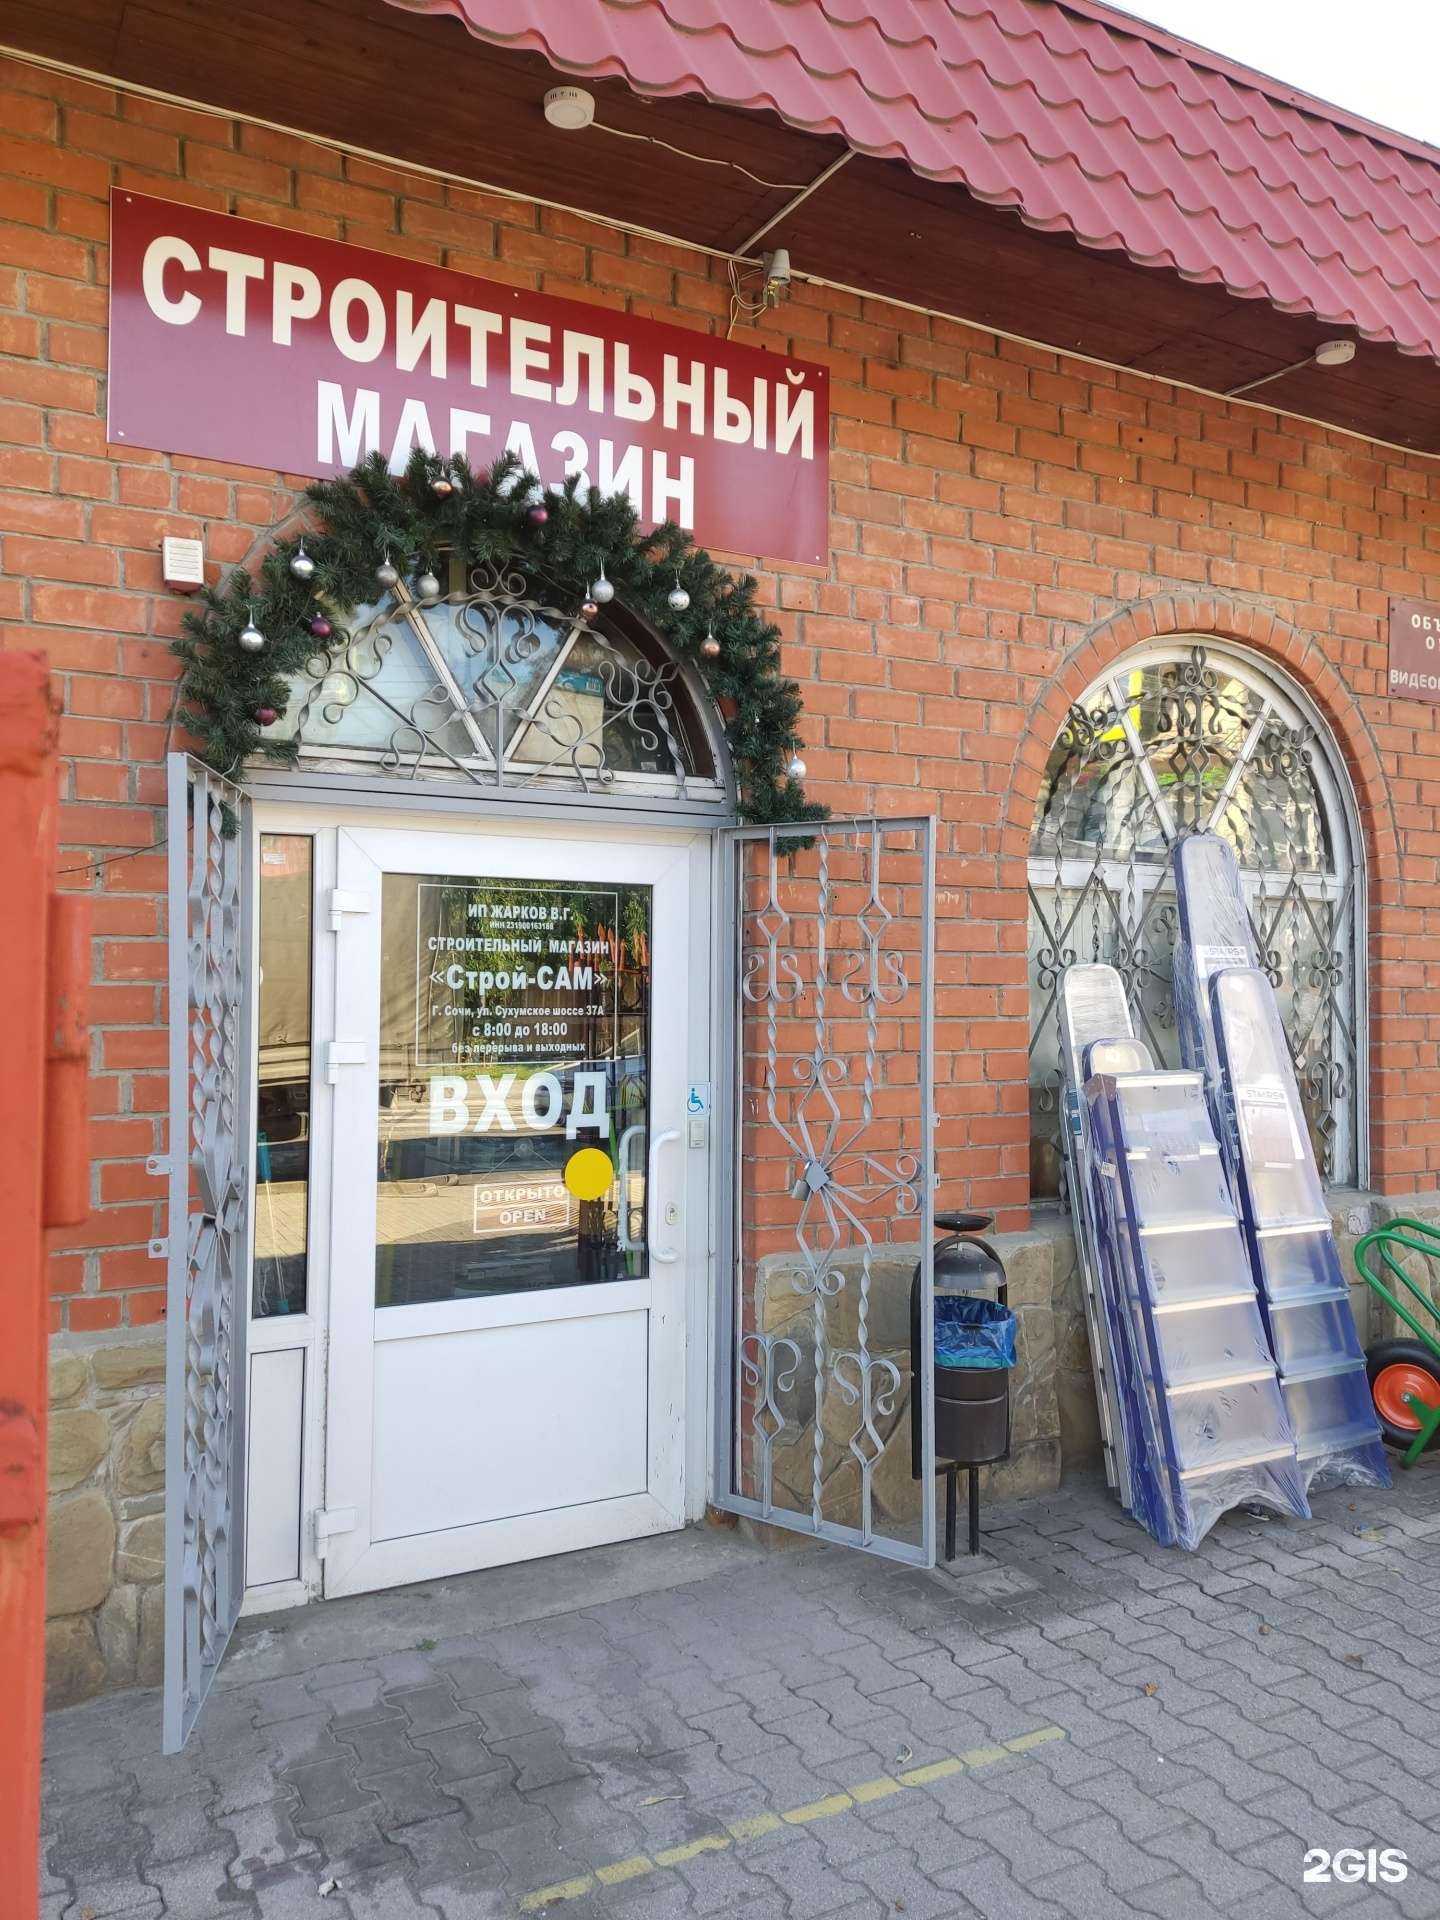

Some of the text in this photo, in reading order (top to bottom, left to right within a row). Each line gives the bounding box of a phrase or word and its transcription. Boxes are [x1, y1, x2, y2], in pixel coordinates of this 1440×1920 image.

[142, 235, 815, 460] СТРОИТЕЛЬНЫЙ
[316, 379, 695, 530] МАГАЗИН
[1390, 668, 1440, 690] ВИДЕО
[468, 903, 574, 921] ИП ЖАРКОВ В.Г.
[428, 936, 609, 954] СТРОИТЕЛЬНЫЙ МАГАЗИН
[429, 963, 608, 996] «Строй-САМ»
[444, 1004, 474, 1018] Сочи,
[477, 1006, 493, 1019] ул.
[495, 1004, 551, 1019] Сухумское
[552, 1007, 584, 1016] шоссе
[586, 1004, 604, 1016] 37А
[472, 1022, 568, 1039] с 8:00 до 18:00
[451, 1042, 586, 1055] без перерыва и выходных
[429, 1071, 610, 1140] ВХОД
[480, 1185, 564, 1203] ОТКРЫТО
[499, 1208, 546, 1225] OPEN
